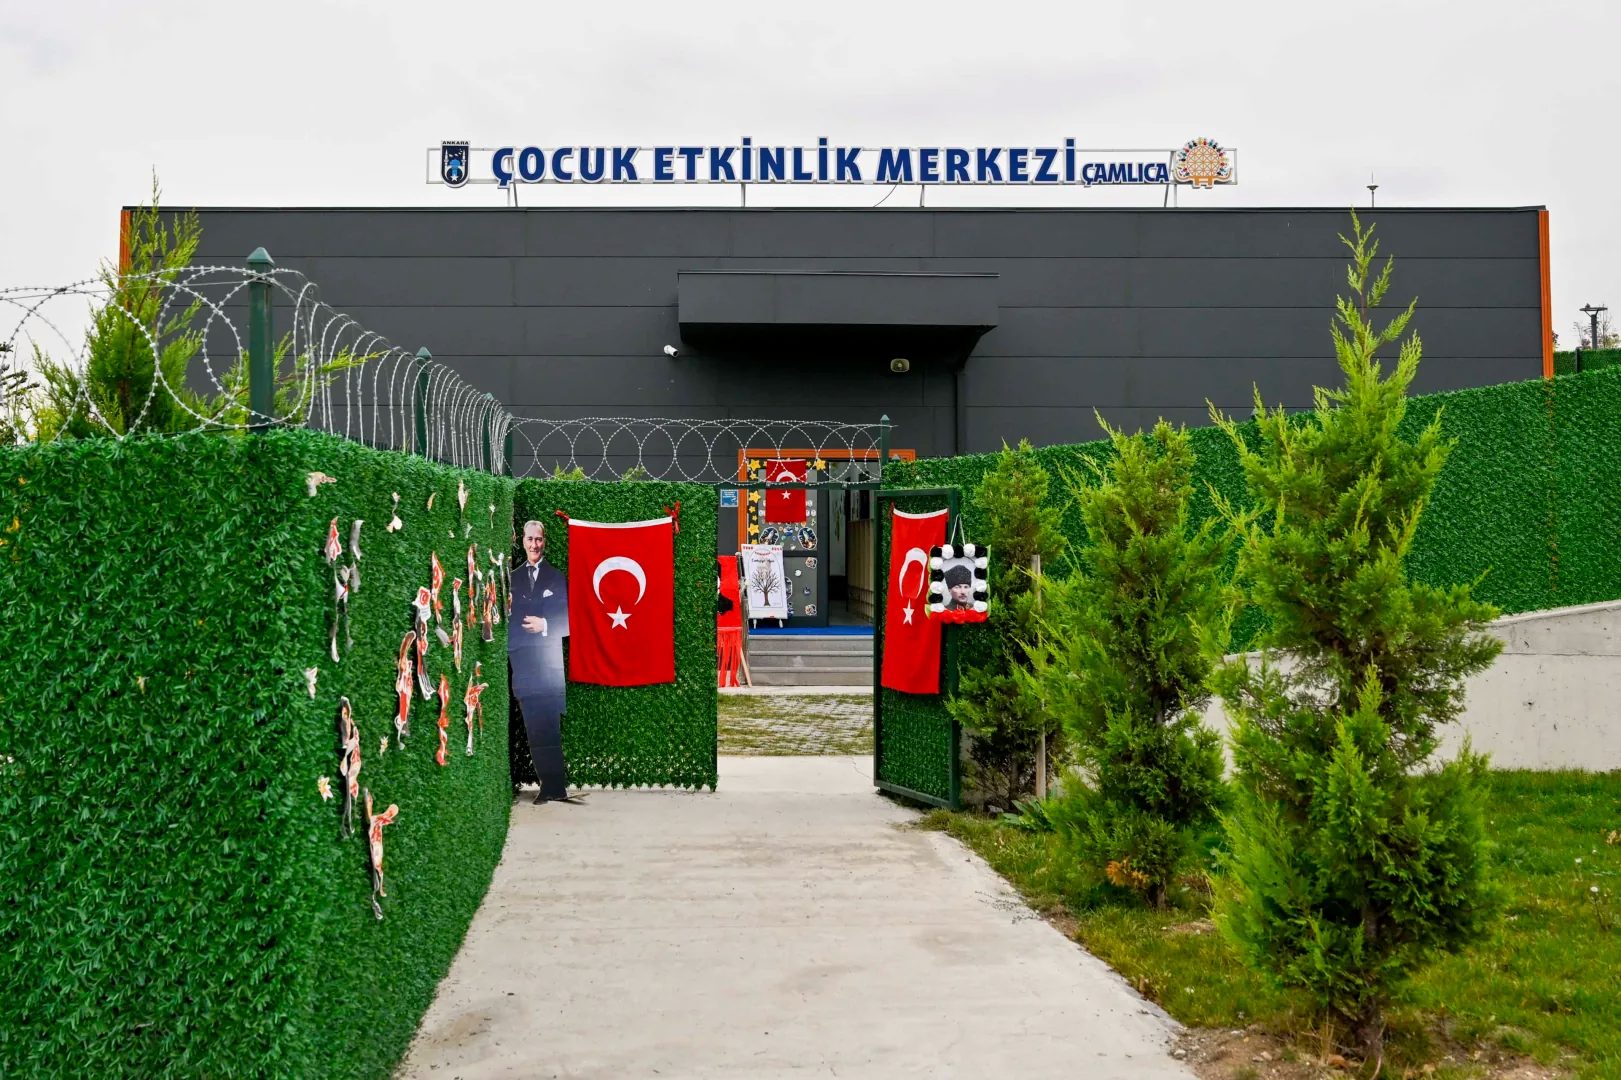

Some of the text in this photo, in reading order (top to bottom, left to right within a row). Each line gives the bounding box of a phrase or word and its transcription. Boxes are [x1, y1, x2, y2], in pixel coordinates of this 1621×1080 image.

[491, 137, 1077, 186] ÇOCUK ETKİNLİK MERKEZİ
[1081, 162, 1170, 187] ÇAMLICA
